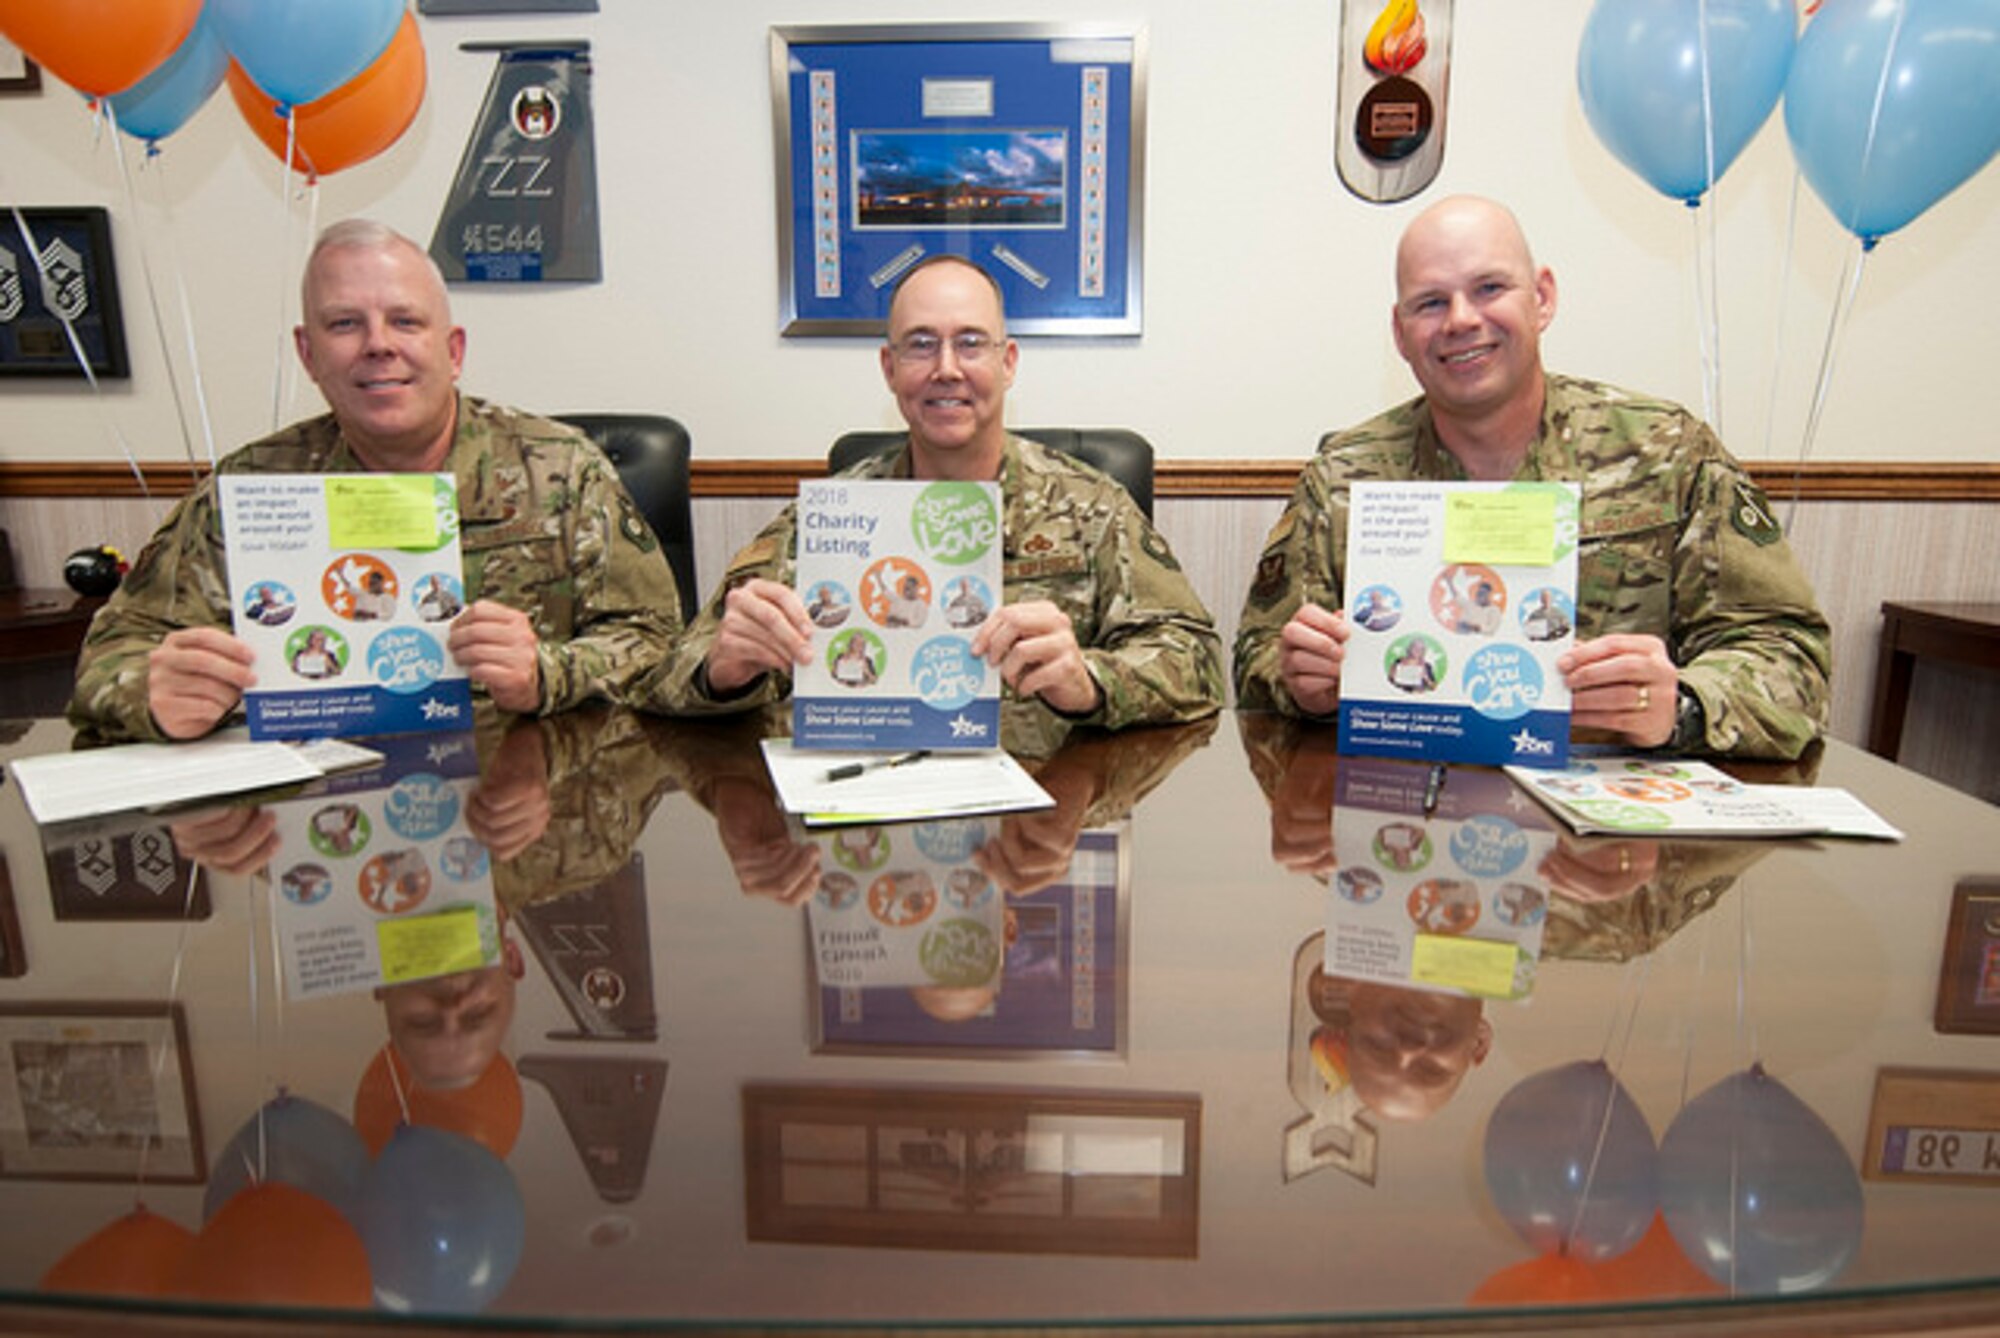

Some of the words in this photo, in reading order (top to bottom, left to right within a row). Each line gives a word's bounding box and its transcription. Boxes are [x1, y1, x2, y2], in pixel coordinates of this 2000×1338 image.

[484, 155, 553, 197] ZZ
[806, 487, 848, 505] 2018
[806, 512, 878, 534] Charity
[806, 536, 870, 558] Listing
